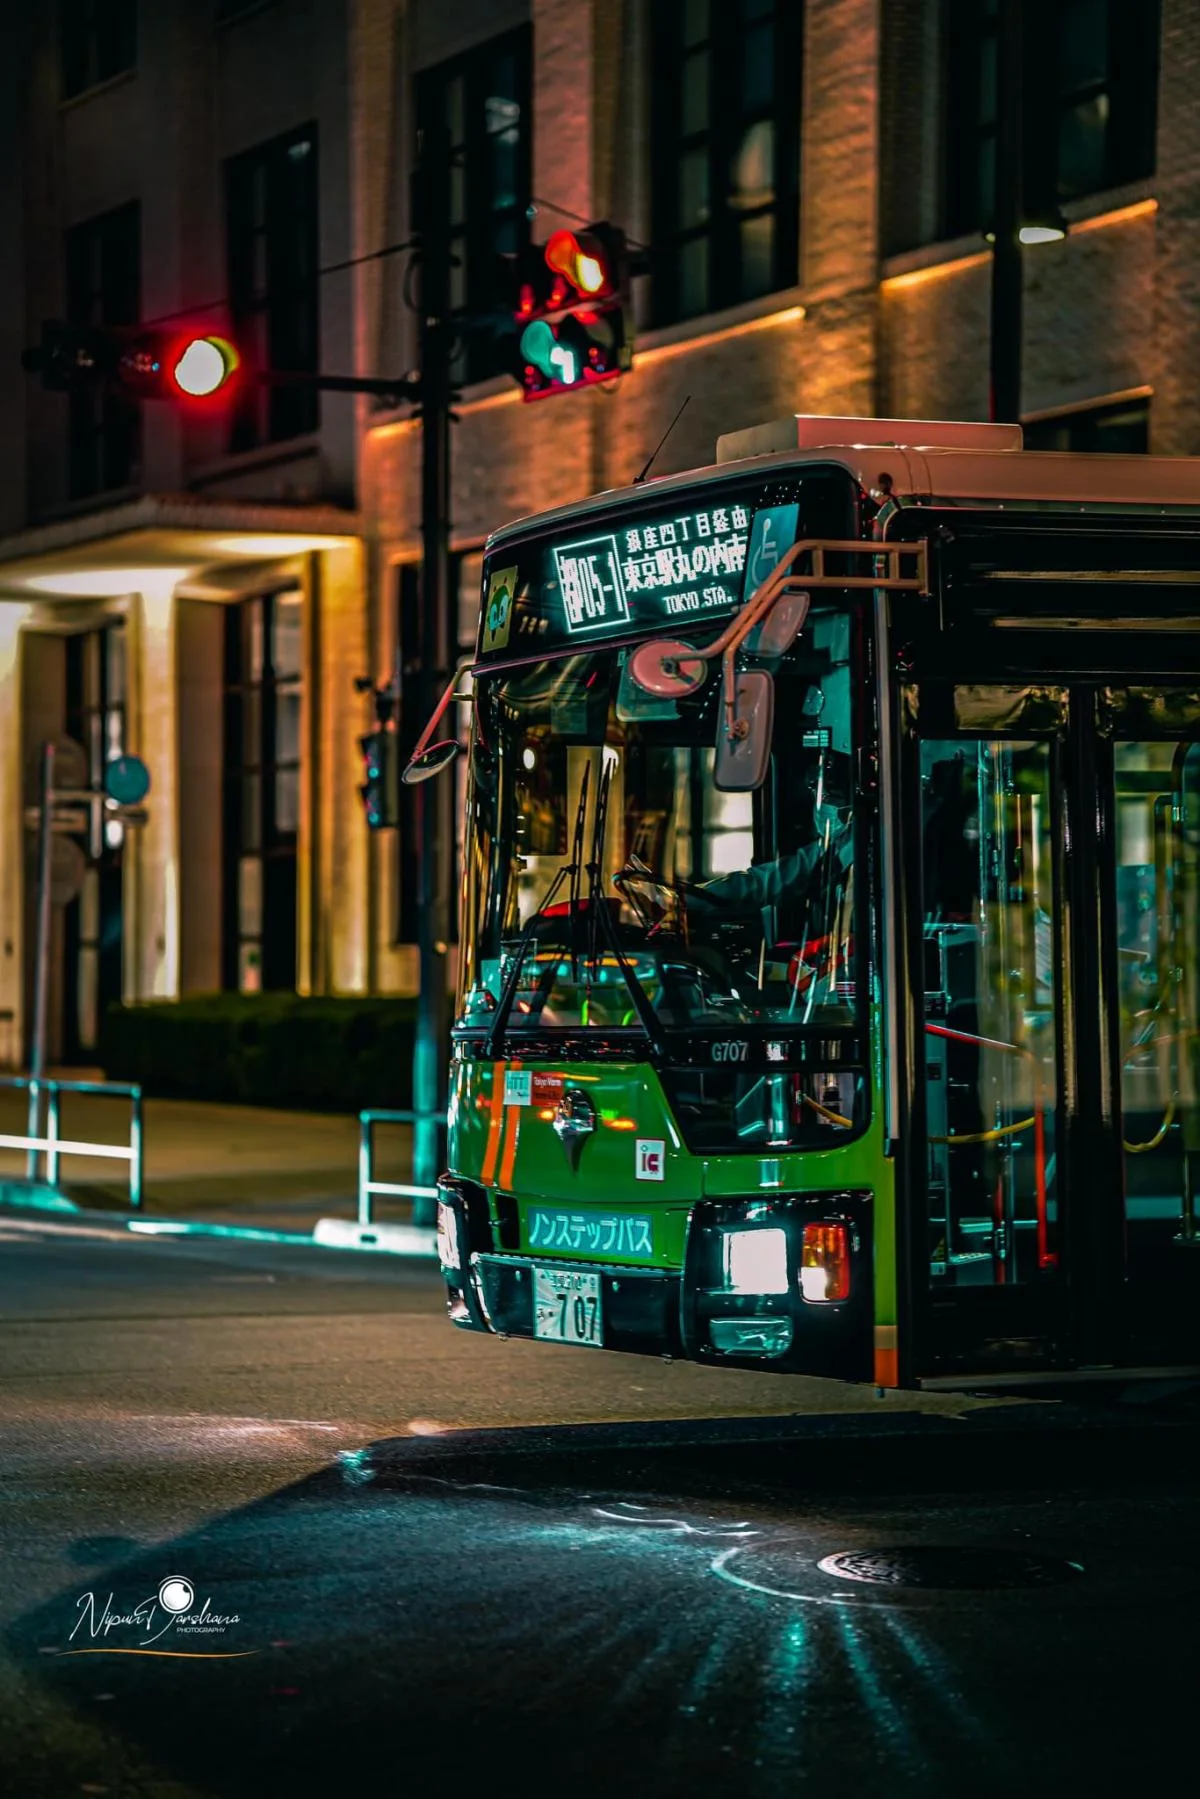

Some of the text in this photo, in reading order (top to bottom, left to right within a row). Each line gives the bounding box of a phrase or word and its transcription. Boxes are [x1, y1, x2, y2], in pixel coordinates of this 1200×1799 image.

[625, 505, 748, 553] 銀座四丁目経由
[662, 586, 733, 614] TOKYO STA.
[712, 1042, 748, 1062] G707
[529, 1213, 652, 1253] ノンステップバス
